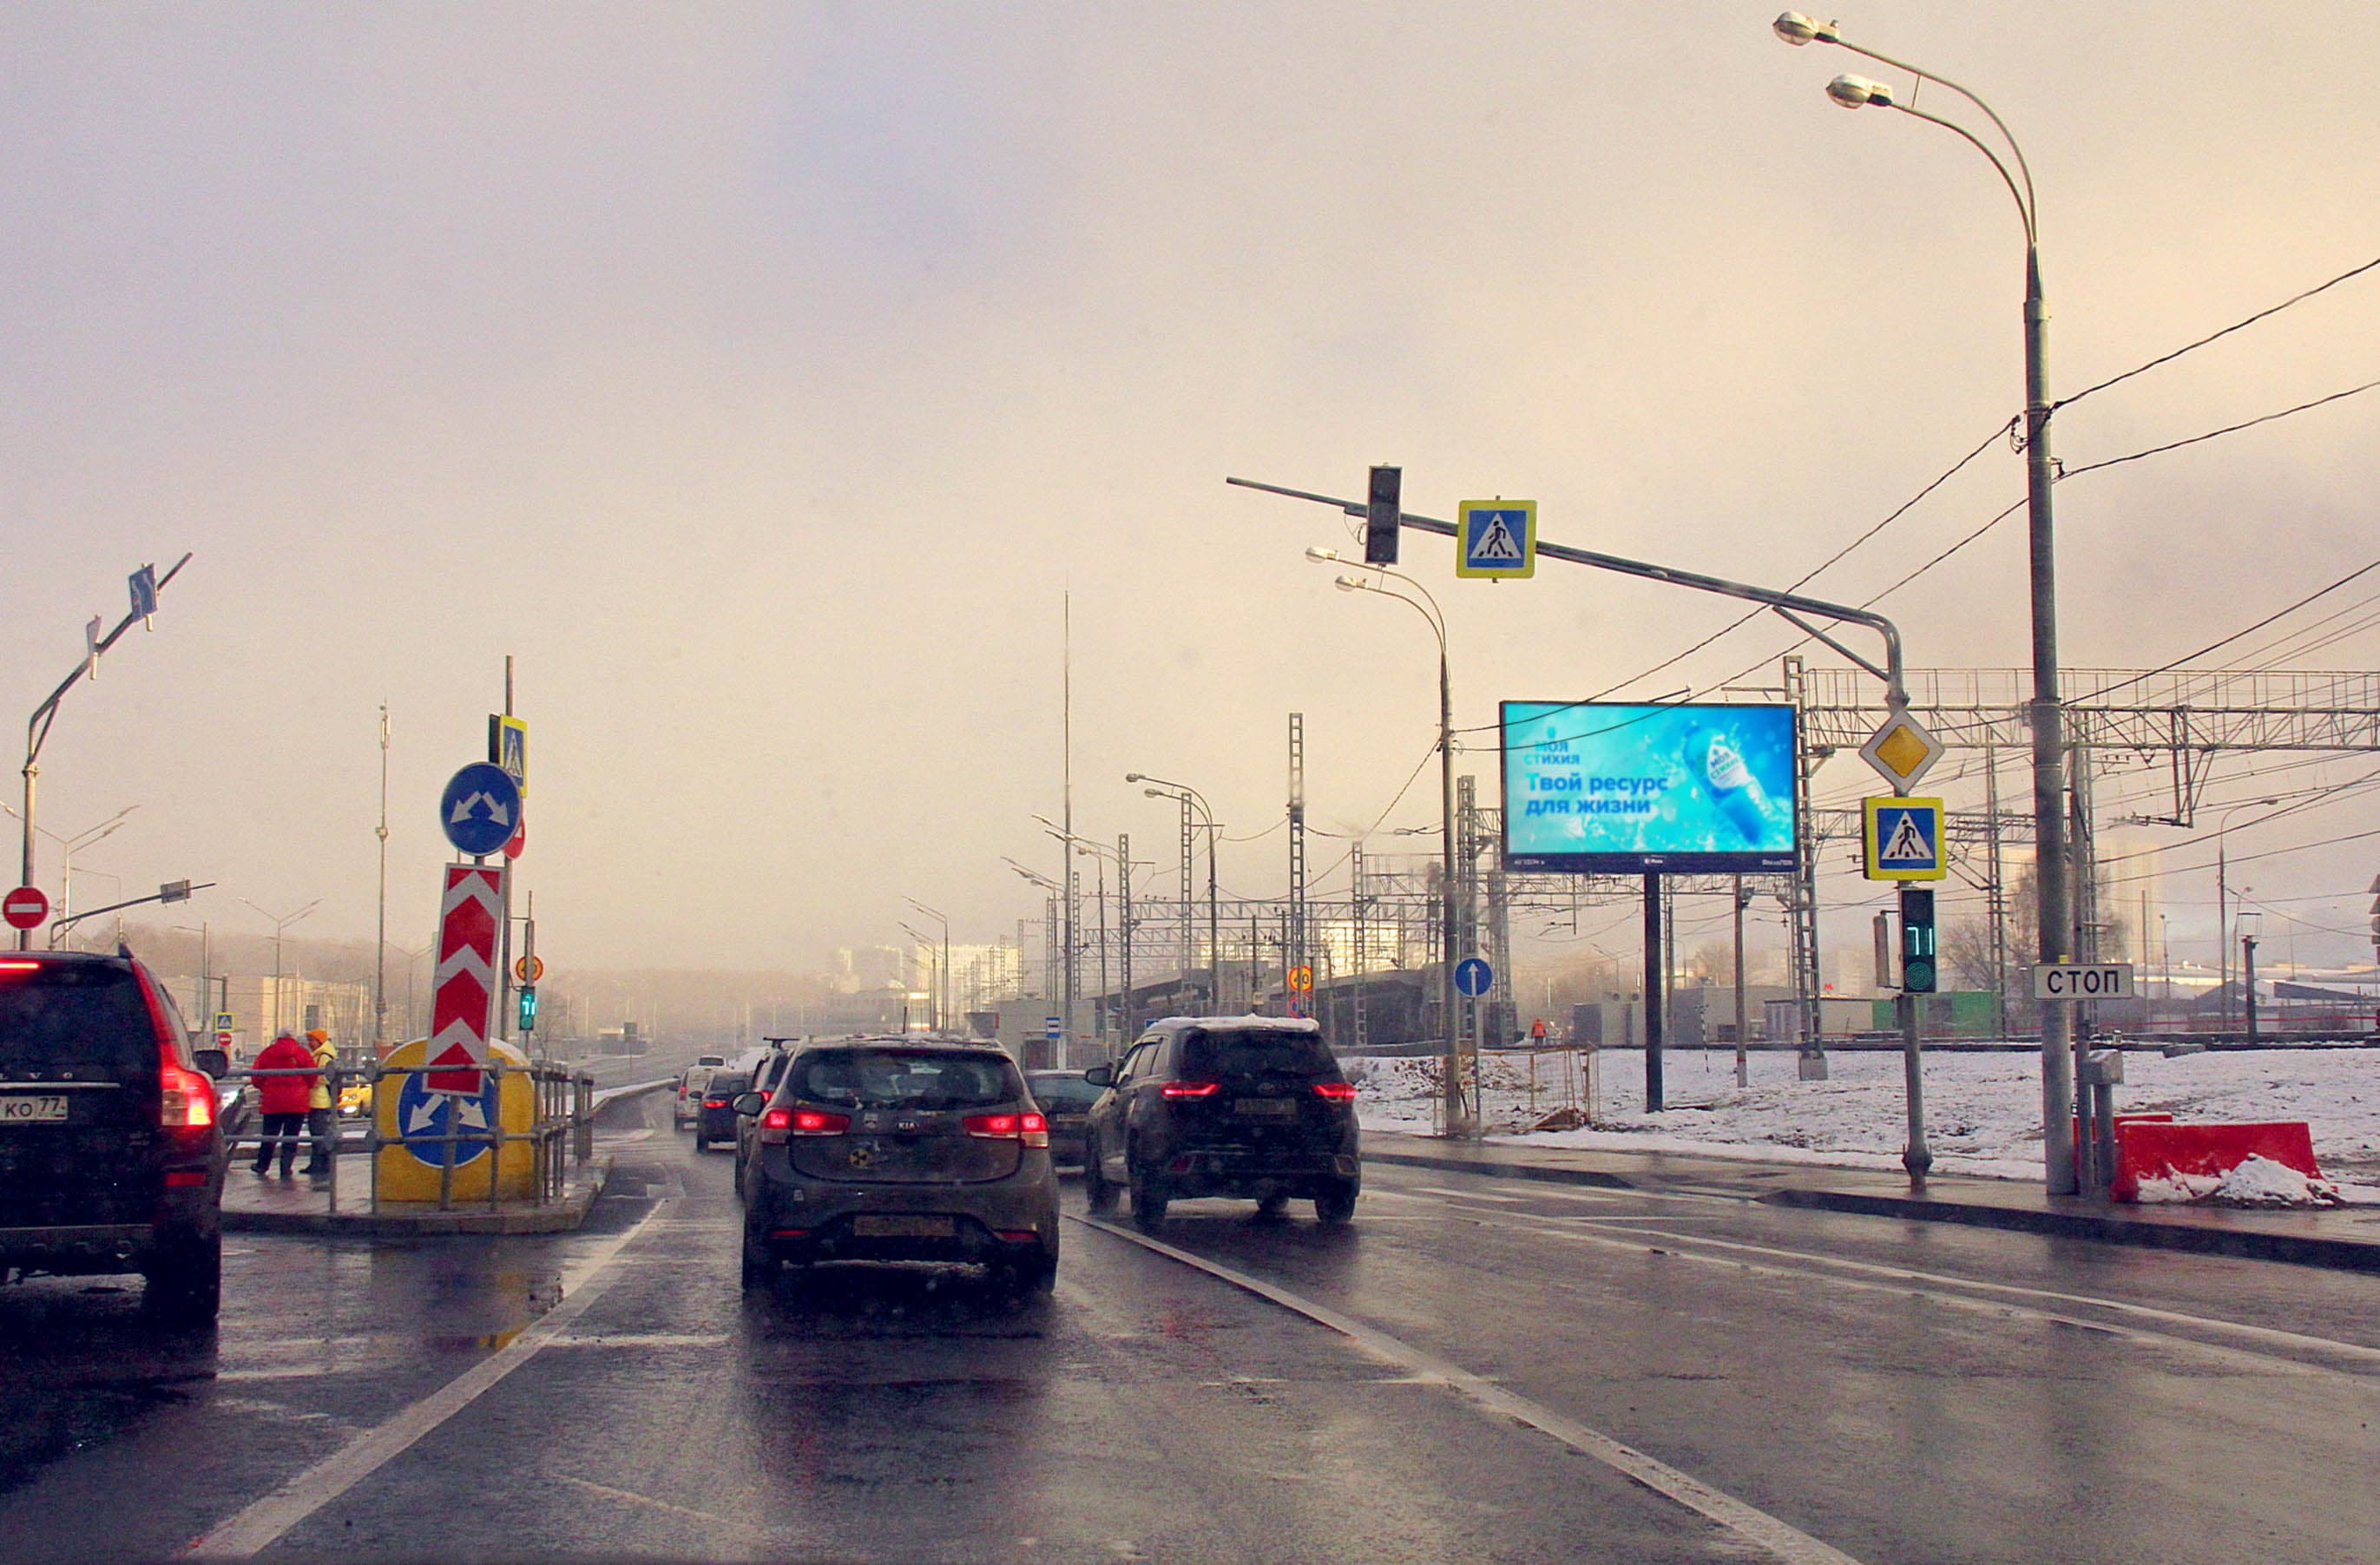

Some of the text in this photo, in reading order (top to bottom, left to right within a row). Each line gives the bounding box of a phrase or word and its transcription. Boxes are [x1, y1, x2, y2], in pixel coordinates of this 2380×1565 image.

[1524, 772, 1668, 796] Твой ресурс
[1525, 799, 1651, 817] для жизни
[2047, 970, 2120, 994] СТОП
[898, 1121, 916, 1130] KIA
